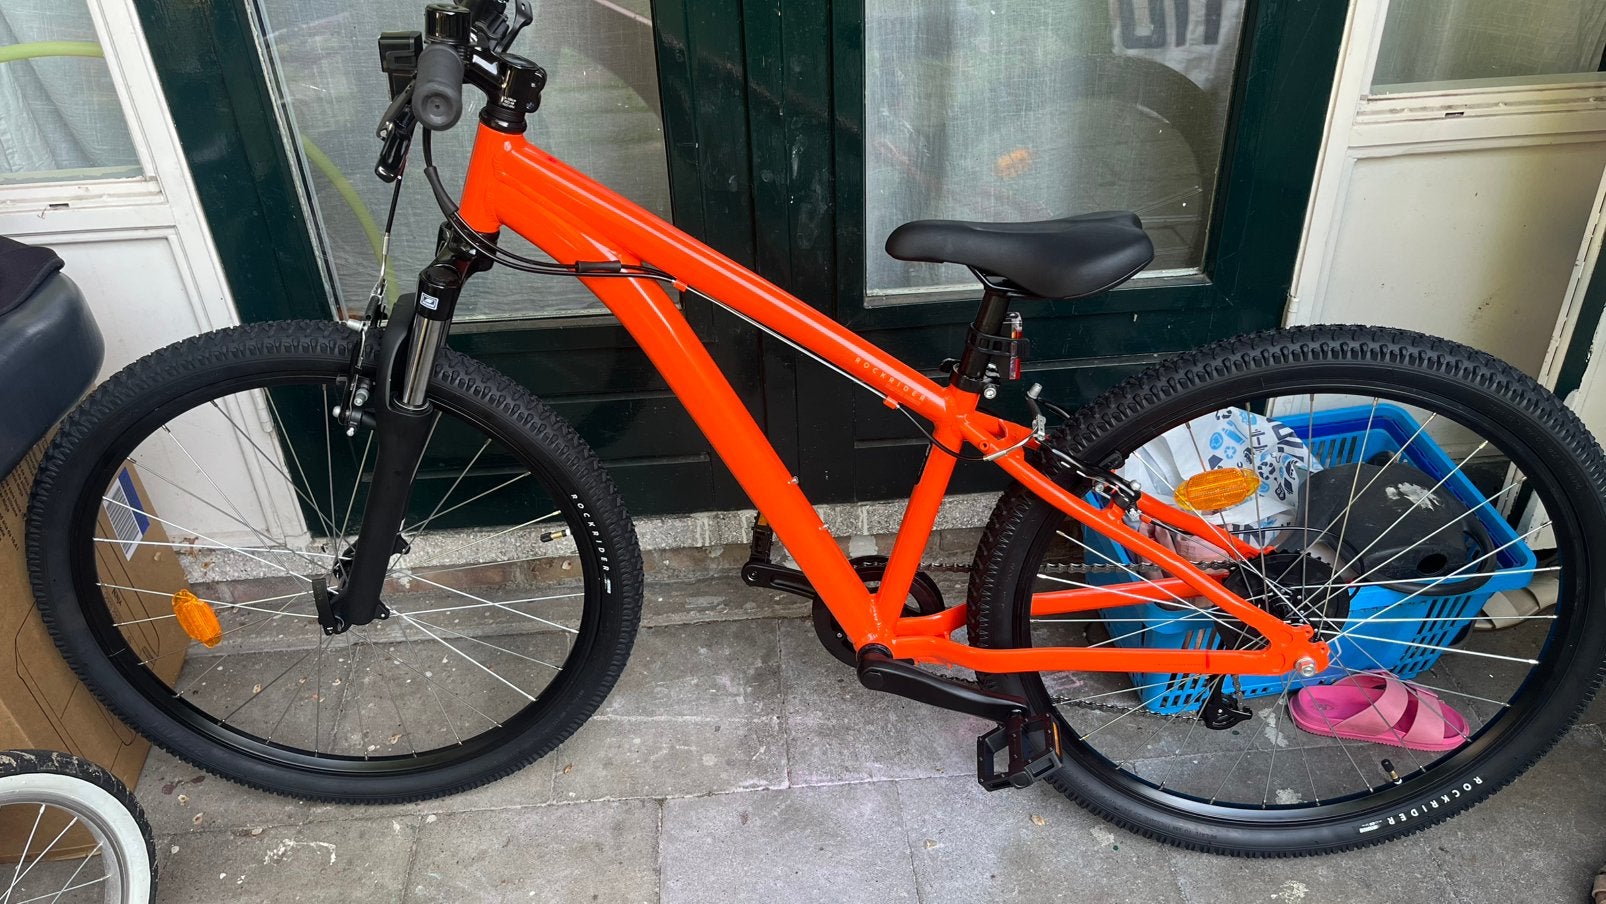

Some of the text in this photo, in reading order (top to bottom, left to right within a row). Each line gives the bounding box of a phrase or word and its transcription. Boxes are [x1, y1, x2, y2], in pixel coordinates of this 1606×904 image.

[855, 356, 927, 402] ROCKRIDER
[571, 493, 610, 572] ROCKRIDER
[1386, 775, 1484, 826] ROCKRIDER
